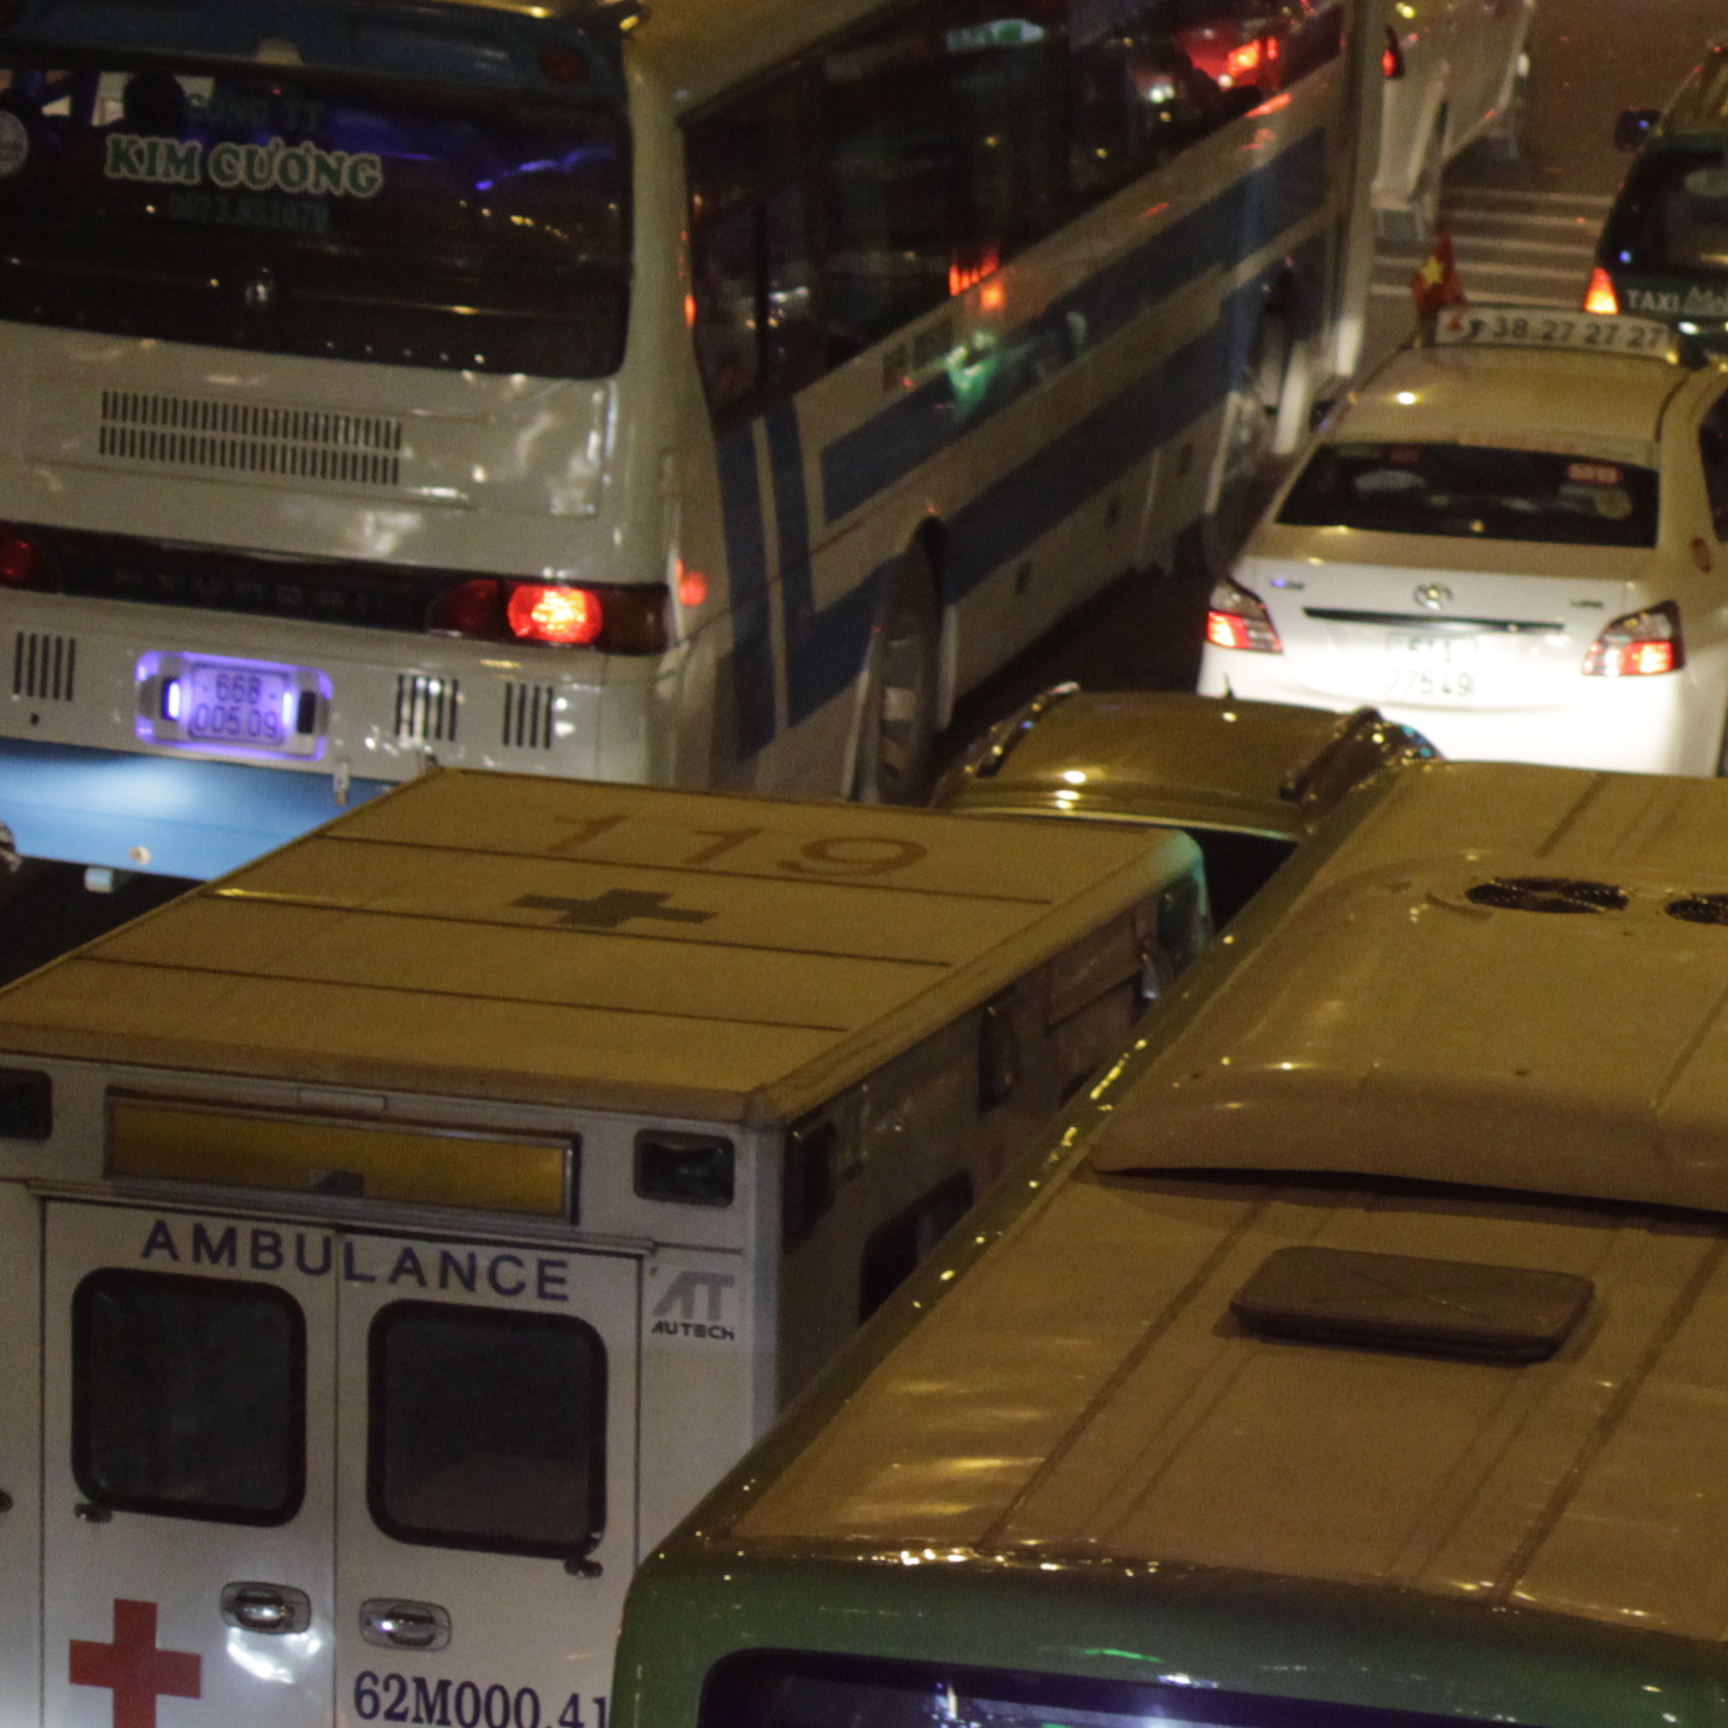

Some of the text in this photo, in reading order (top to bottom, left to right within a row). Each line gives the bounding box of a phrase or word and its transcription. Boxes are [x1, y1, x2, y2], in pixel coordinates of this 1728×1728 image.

[104, 133, 204, 185] KIM
[1627, 289, 1682, 313] TAXI
[546, 813, 929, 878] 119
[142, 1220, 570, 1301] AMBULANCE
[651, 1320, 735, 1341] AUTECH
